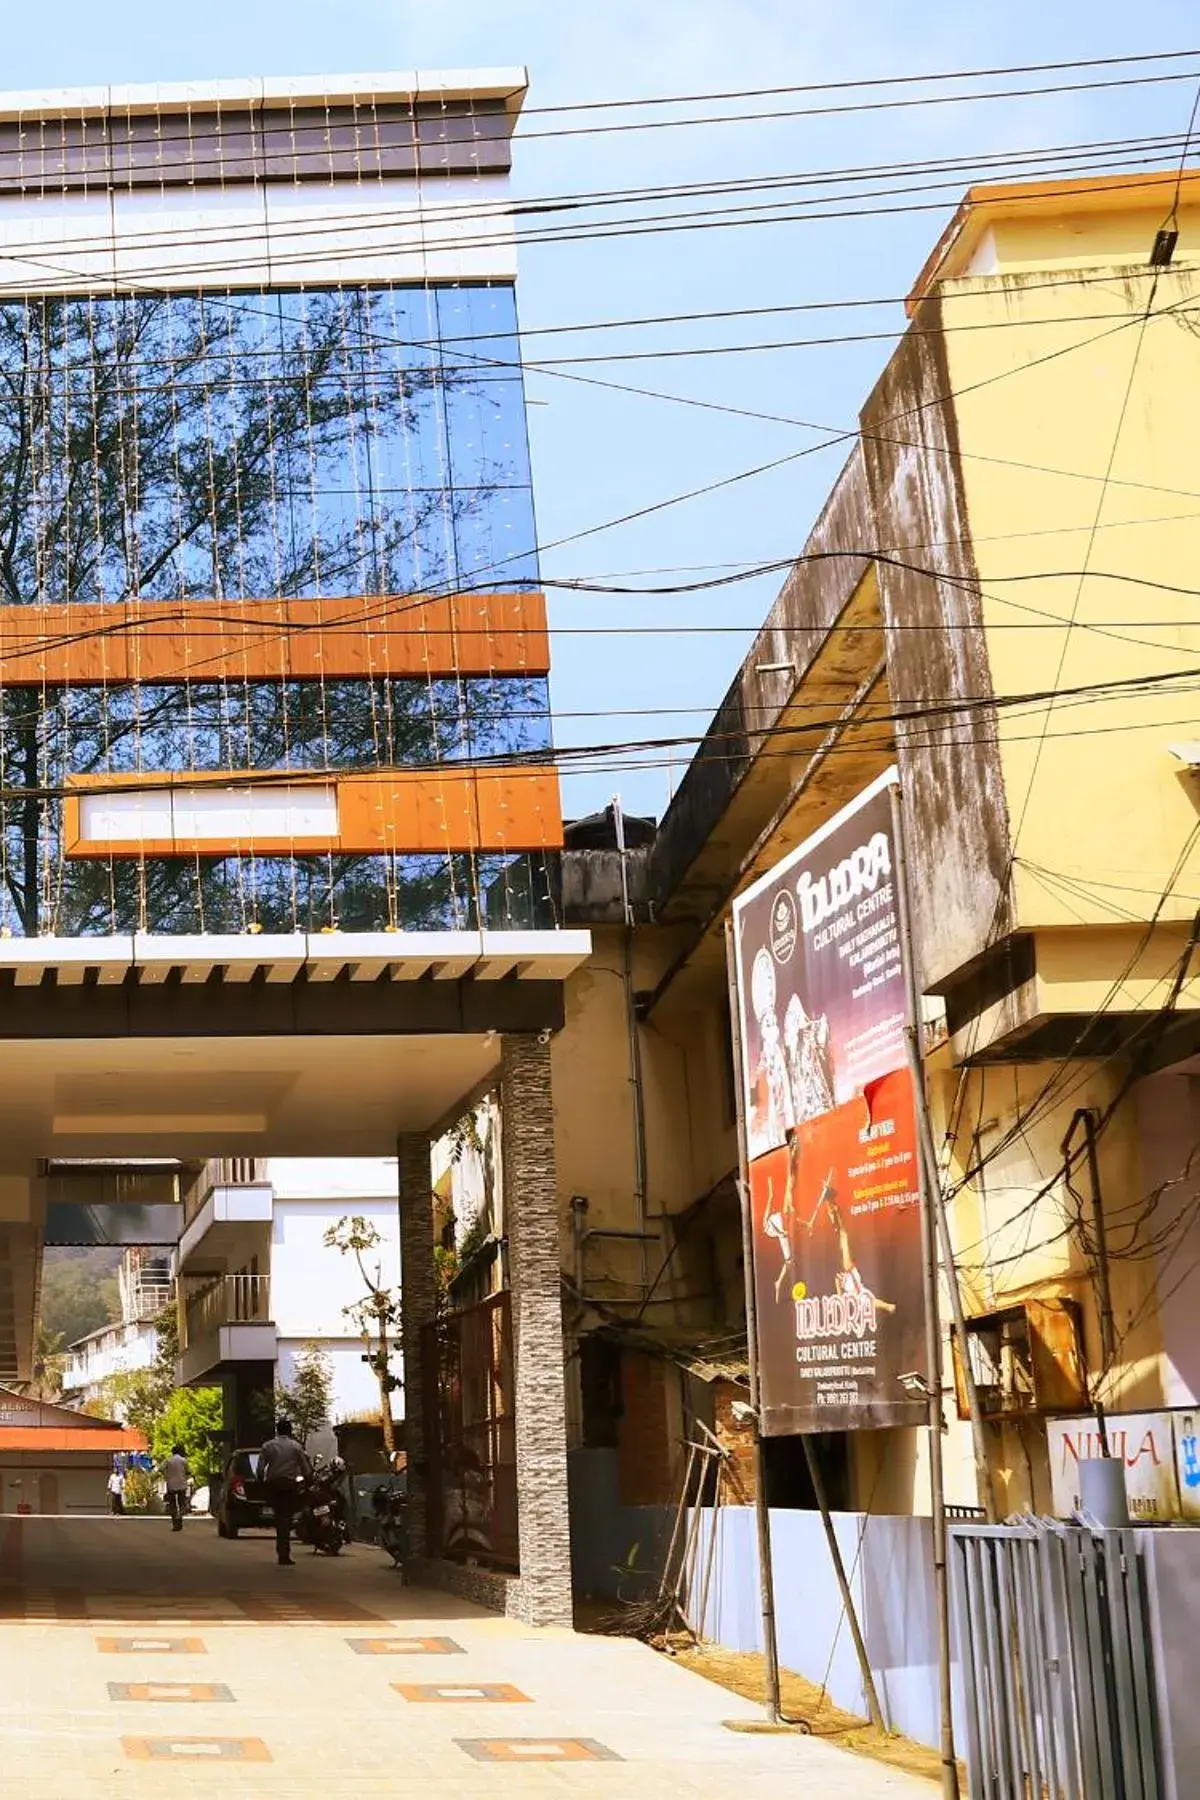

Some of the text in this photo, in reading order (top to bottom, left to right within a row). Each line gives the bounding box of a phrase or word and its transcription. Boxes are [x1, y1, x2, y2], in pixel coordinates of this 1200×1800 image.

[814, 911, 856, 951] CULTURAL
[857, 882, 894, 921] CENTRE
[796, 1340, 877, 1362] CULTURAL CENTRE
[1062, 1430, 1161, 1474] NINJA
